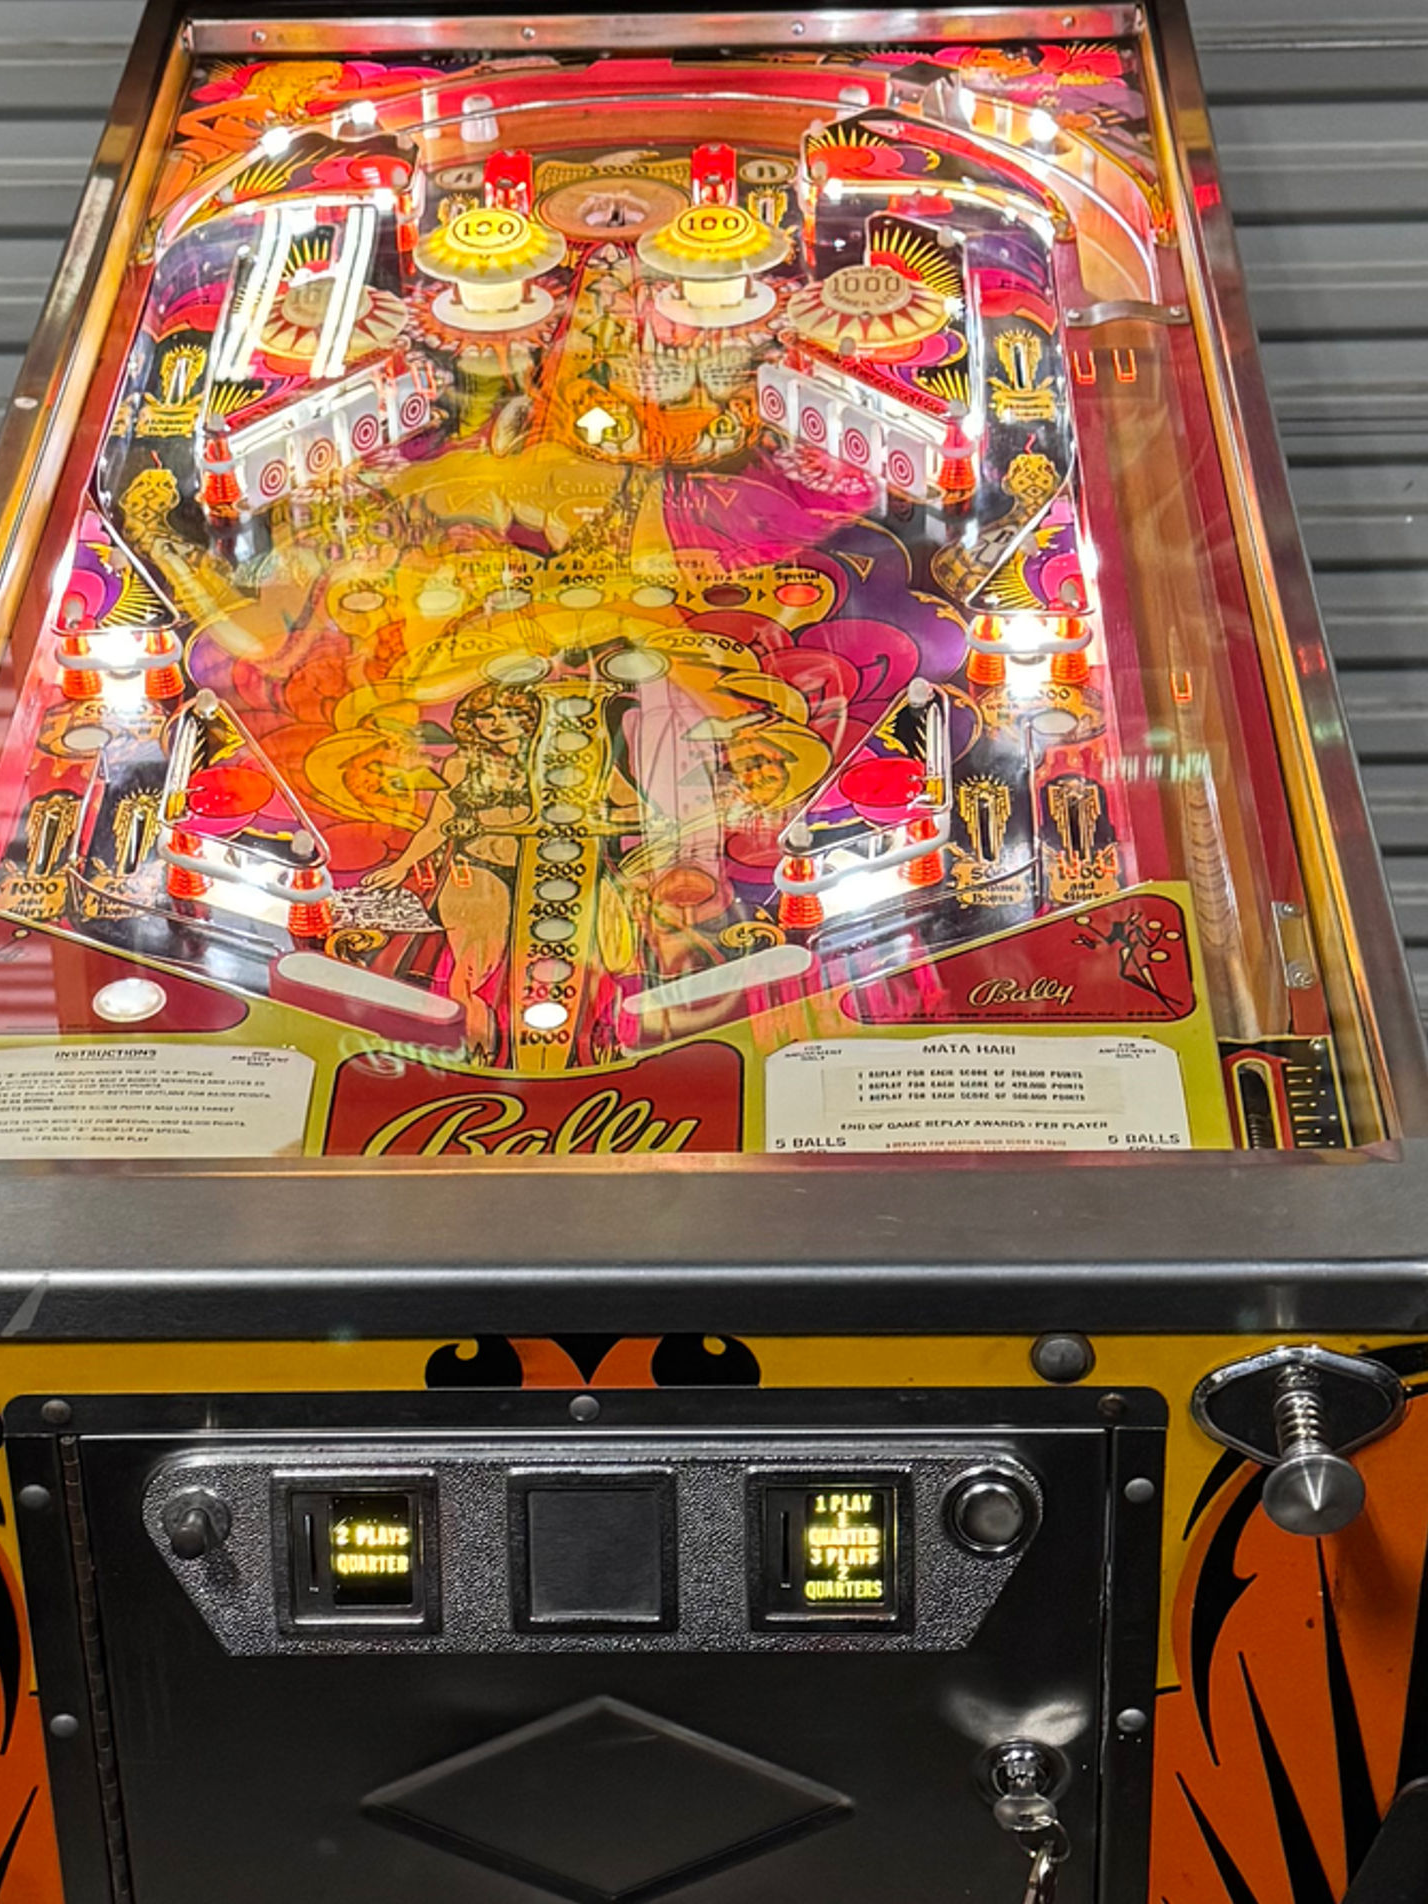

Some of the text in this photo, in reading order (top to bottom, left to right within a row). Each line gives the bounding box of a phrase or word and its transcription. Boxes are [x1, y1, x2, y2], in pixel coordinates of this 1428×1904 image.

[687, 216, 740, 232] 100
[832, 276, 901, 293] 1000
[534, 864, 587, 877] 5000
[12, 882, 59, 895] 1000
[529, 903, 582, 916] 4000
[527, 943, 579, 957] 3000
[523, 984, 576, 998] 2000
[969, 977, 1074, 1006] Bally
[519, 1030, 571, 1044] 1000
[922, 1044, 1016, 1055] MATA HARI
[362, 1088, 703, 1156] Bally
[887, 1121, 921, 1130] GAME
[925, 1120, 970, 1128] REPLAY
[974, 1121, 1025, 1129] AWARDS
[1063, 1121, 1108, 1129] PLAYER
[793, 1137, 847, 1148] BALLS
[1125, 1134, 1181, 1145] BALLS
[815, 1495, 872, 1513] 1 PLAY
[335, 1525, 410, 1546] 2 PLAYS
[808, 1527, 880, 1545] QUARTER
[826, 1547, 880, 1565] PLAYS
[336, 1554, 410, 1575] QUARTER
[805, 1580, 883, 1600] QUARTERS
